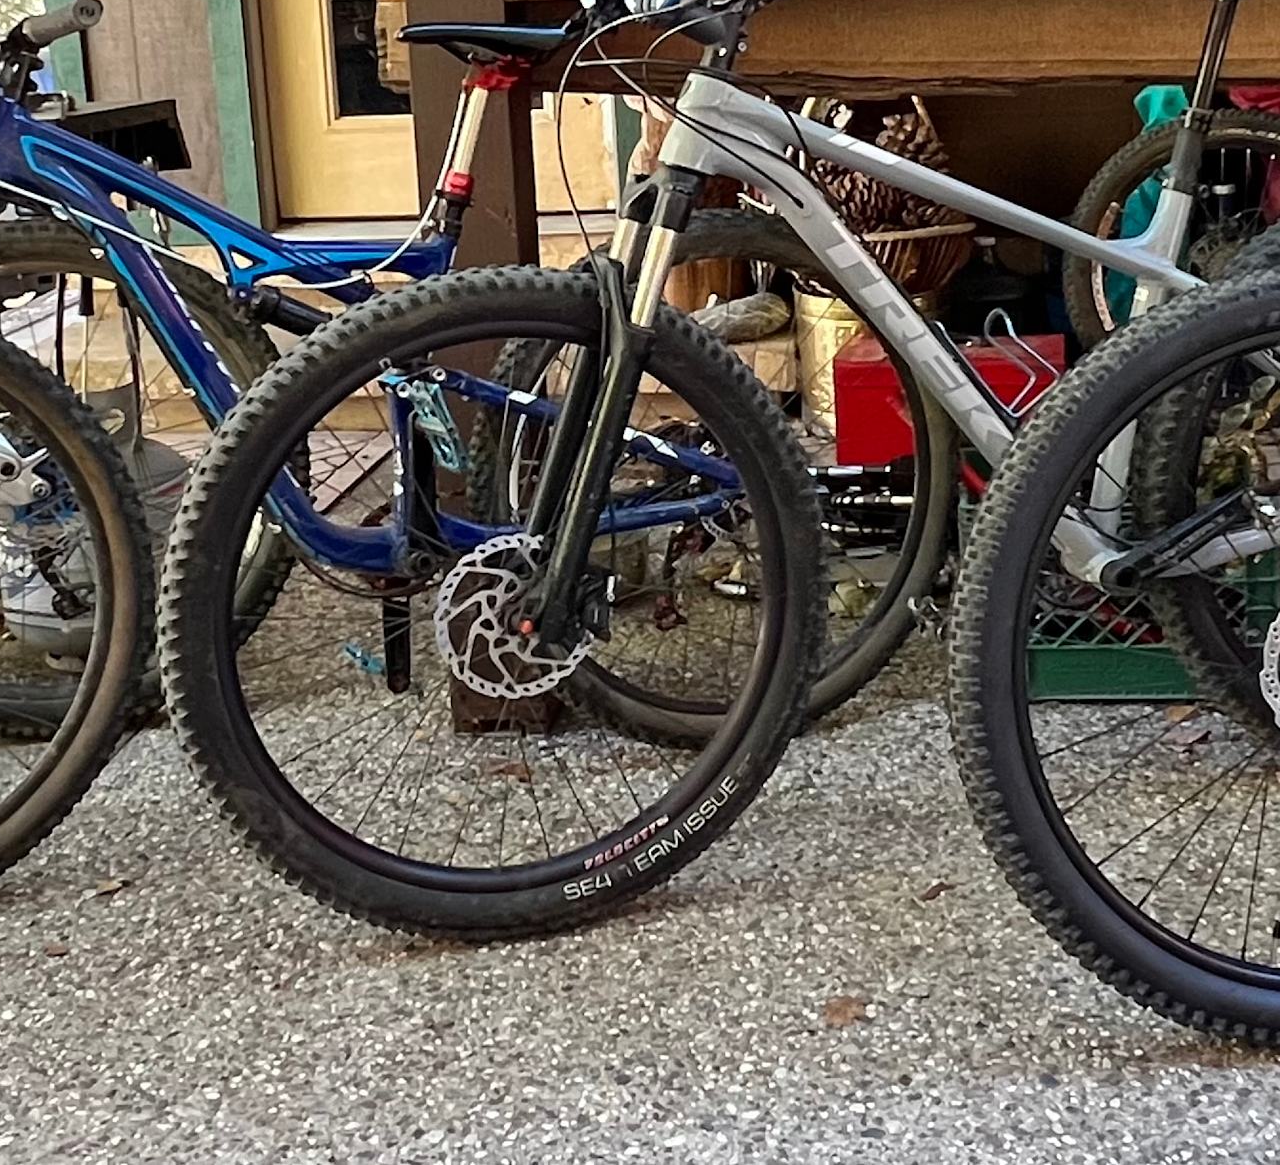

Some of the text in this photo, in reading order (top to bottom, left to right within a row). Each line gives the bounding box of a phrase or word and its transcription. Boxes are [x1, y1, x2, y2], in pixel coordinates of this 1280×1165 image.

[825, 220, 1014, 442] TREK
[562, 873, 612, 901] SE4
[682, 775, 738, 835] ISSUE
